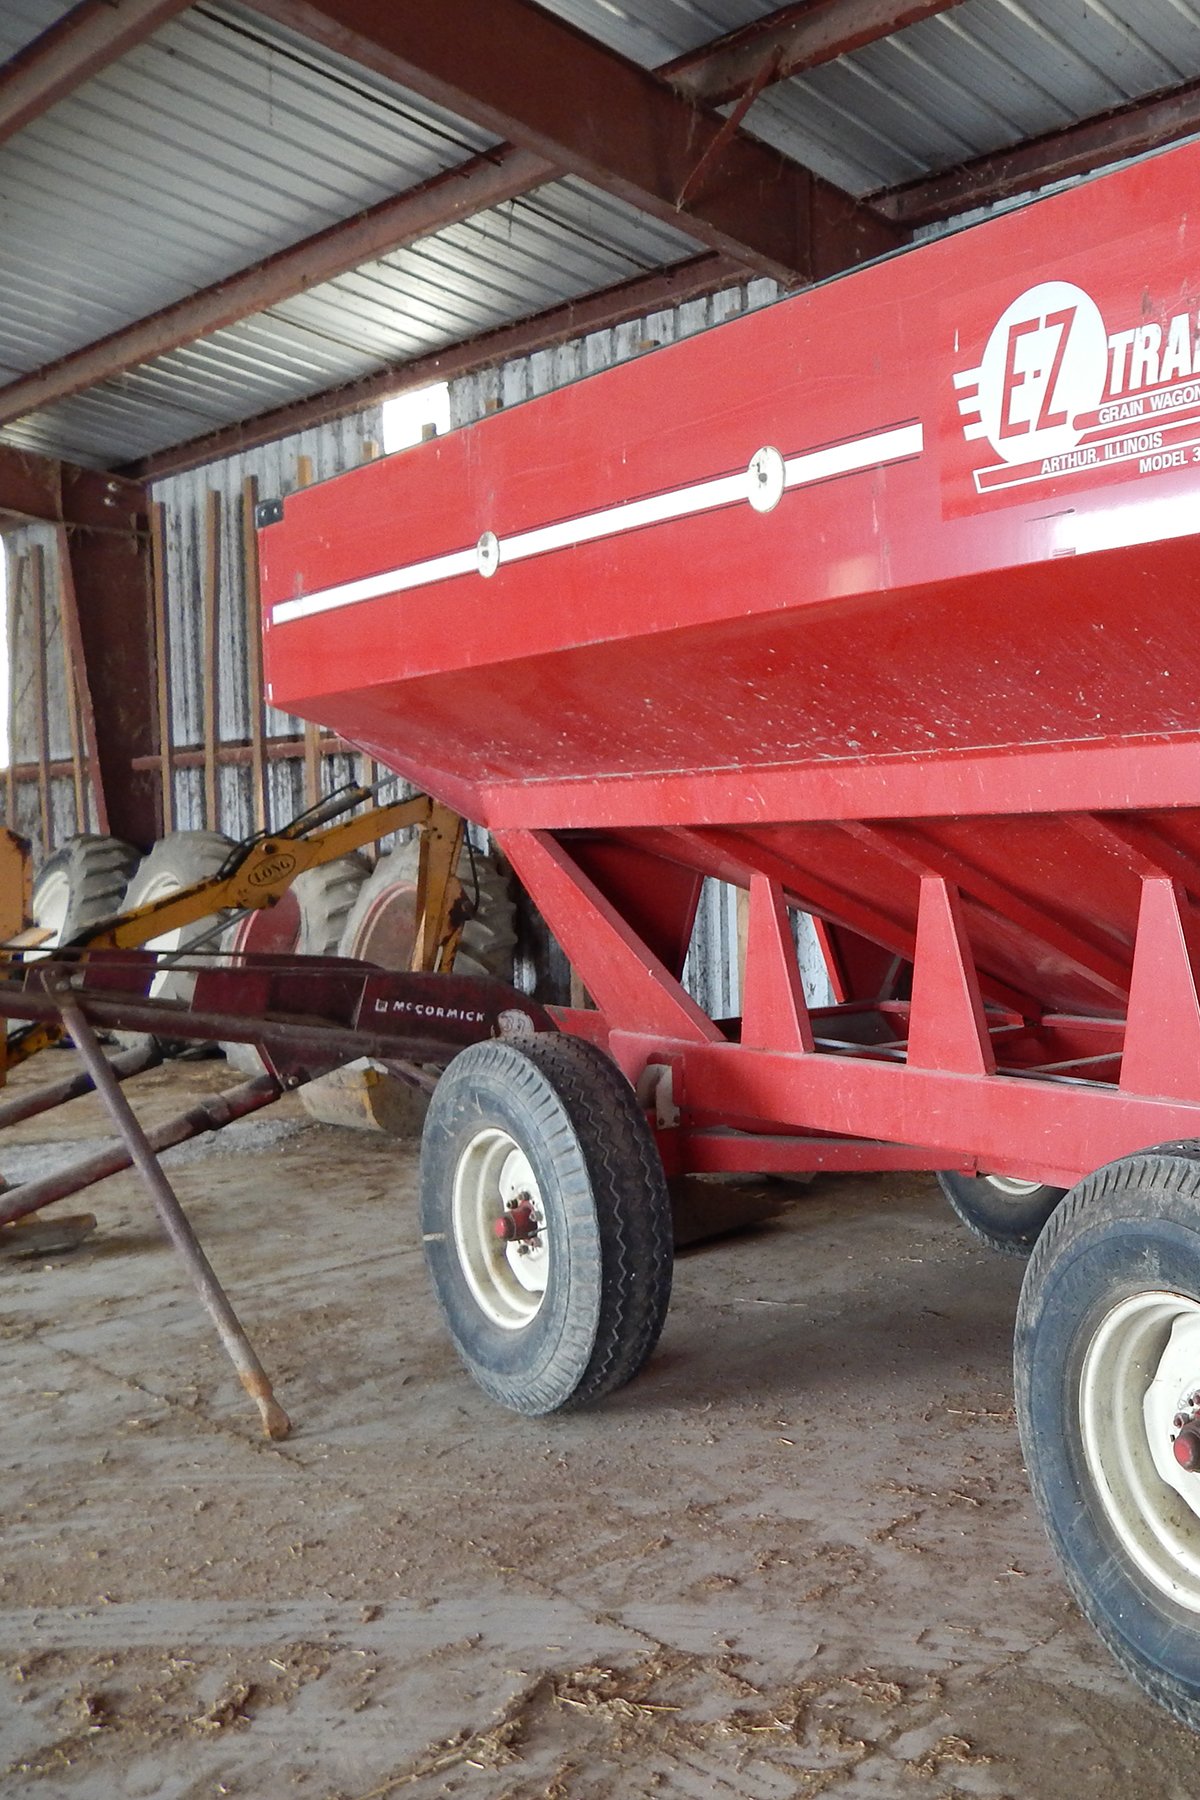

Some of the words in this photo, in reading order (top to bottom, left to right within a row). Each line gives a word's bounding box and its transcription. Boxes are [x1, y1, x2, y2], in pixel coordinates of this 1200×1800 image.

[1098, 400, 1144, 424] GRAIN
[1041, 448, 1101, 474] ARTHUR,
[1104, 432, 1163, 460] ILLINOIS
[1139, 454, 1188, 473] MODEL
[254, 860, 291, 883] LONG
